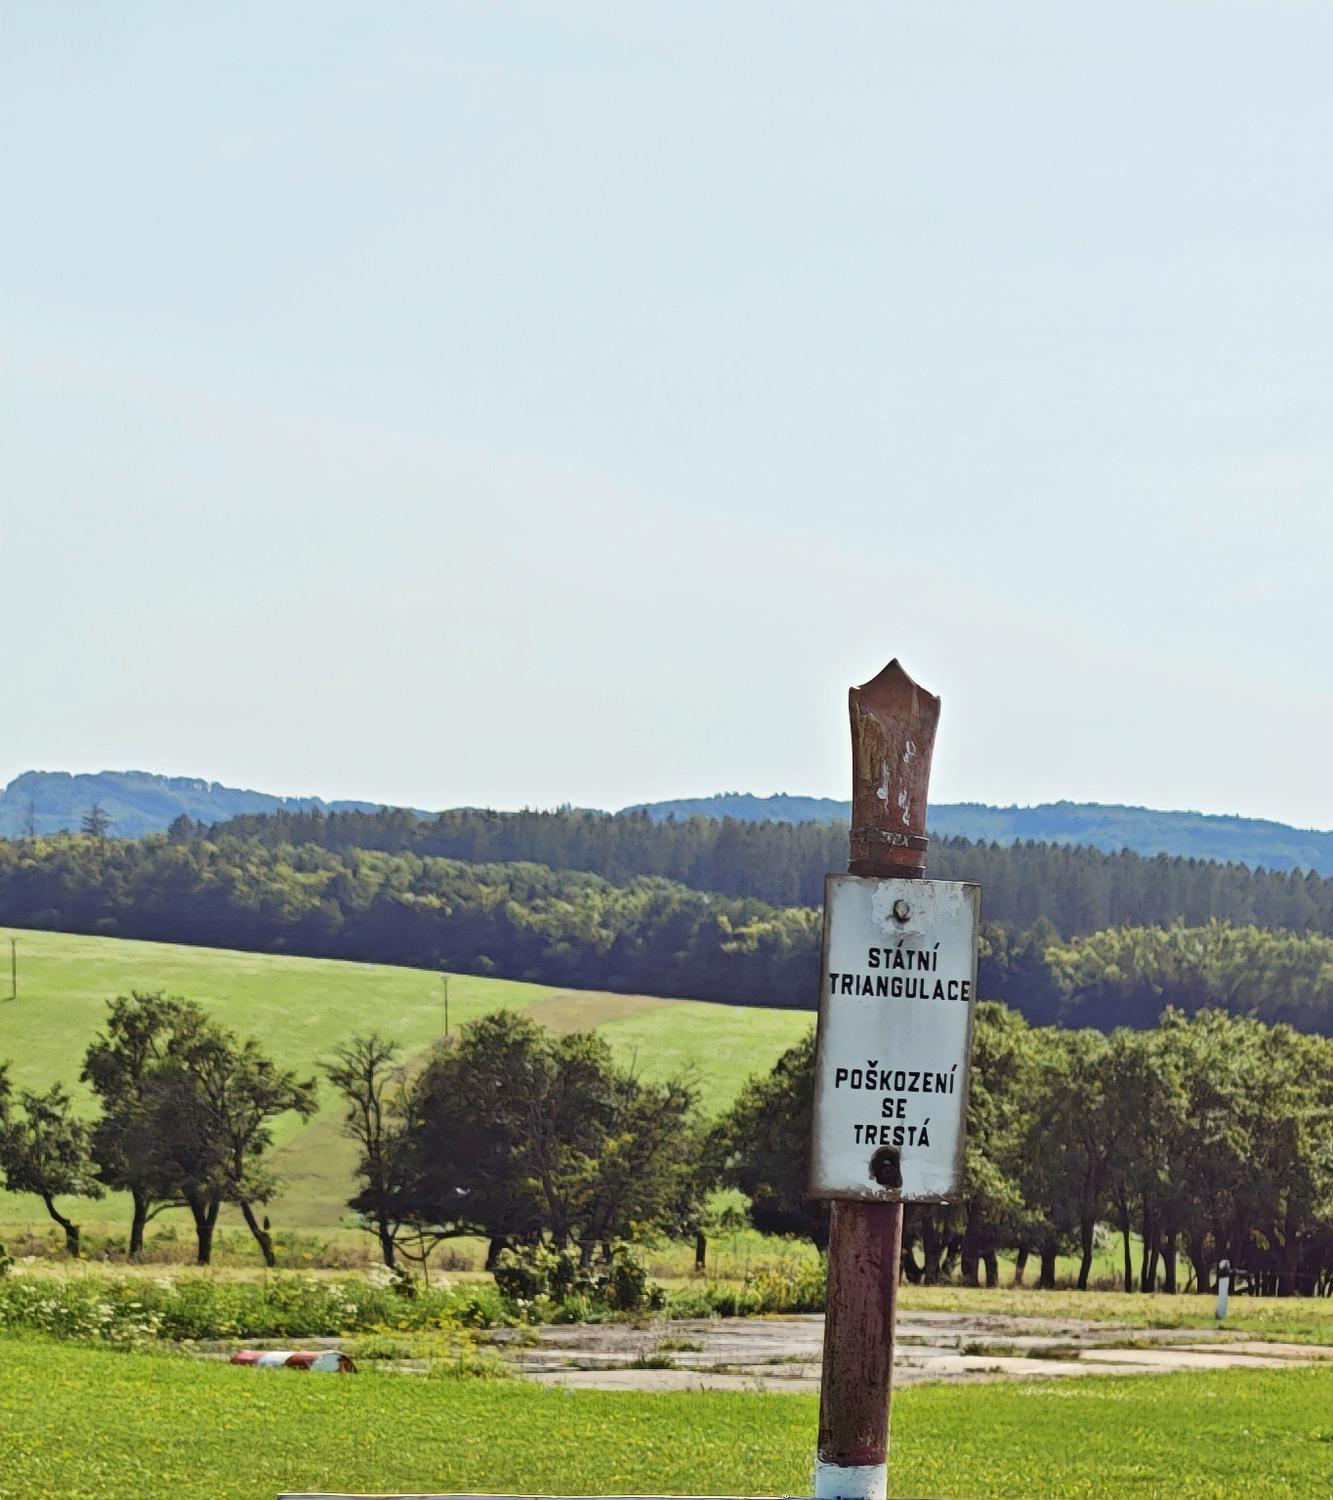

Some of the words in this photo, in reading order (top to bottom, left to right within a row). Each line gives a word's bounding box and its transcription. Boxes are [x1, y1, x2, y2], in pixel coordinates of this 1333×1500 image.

[868, 940, 940, 972] STÁTNÍ
[830, 973, 971, 1001] TRIANGULACE
[835, 1060, 958, 1095] POŠKOZENÍ
[882, 1098, 907, 1119] SE
[854, 1118, 930, 1147] TRESTÁ
